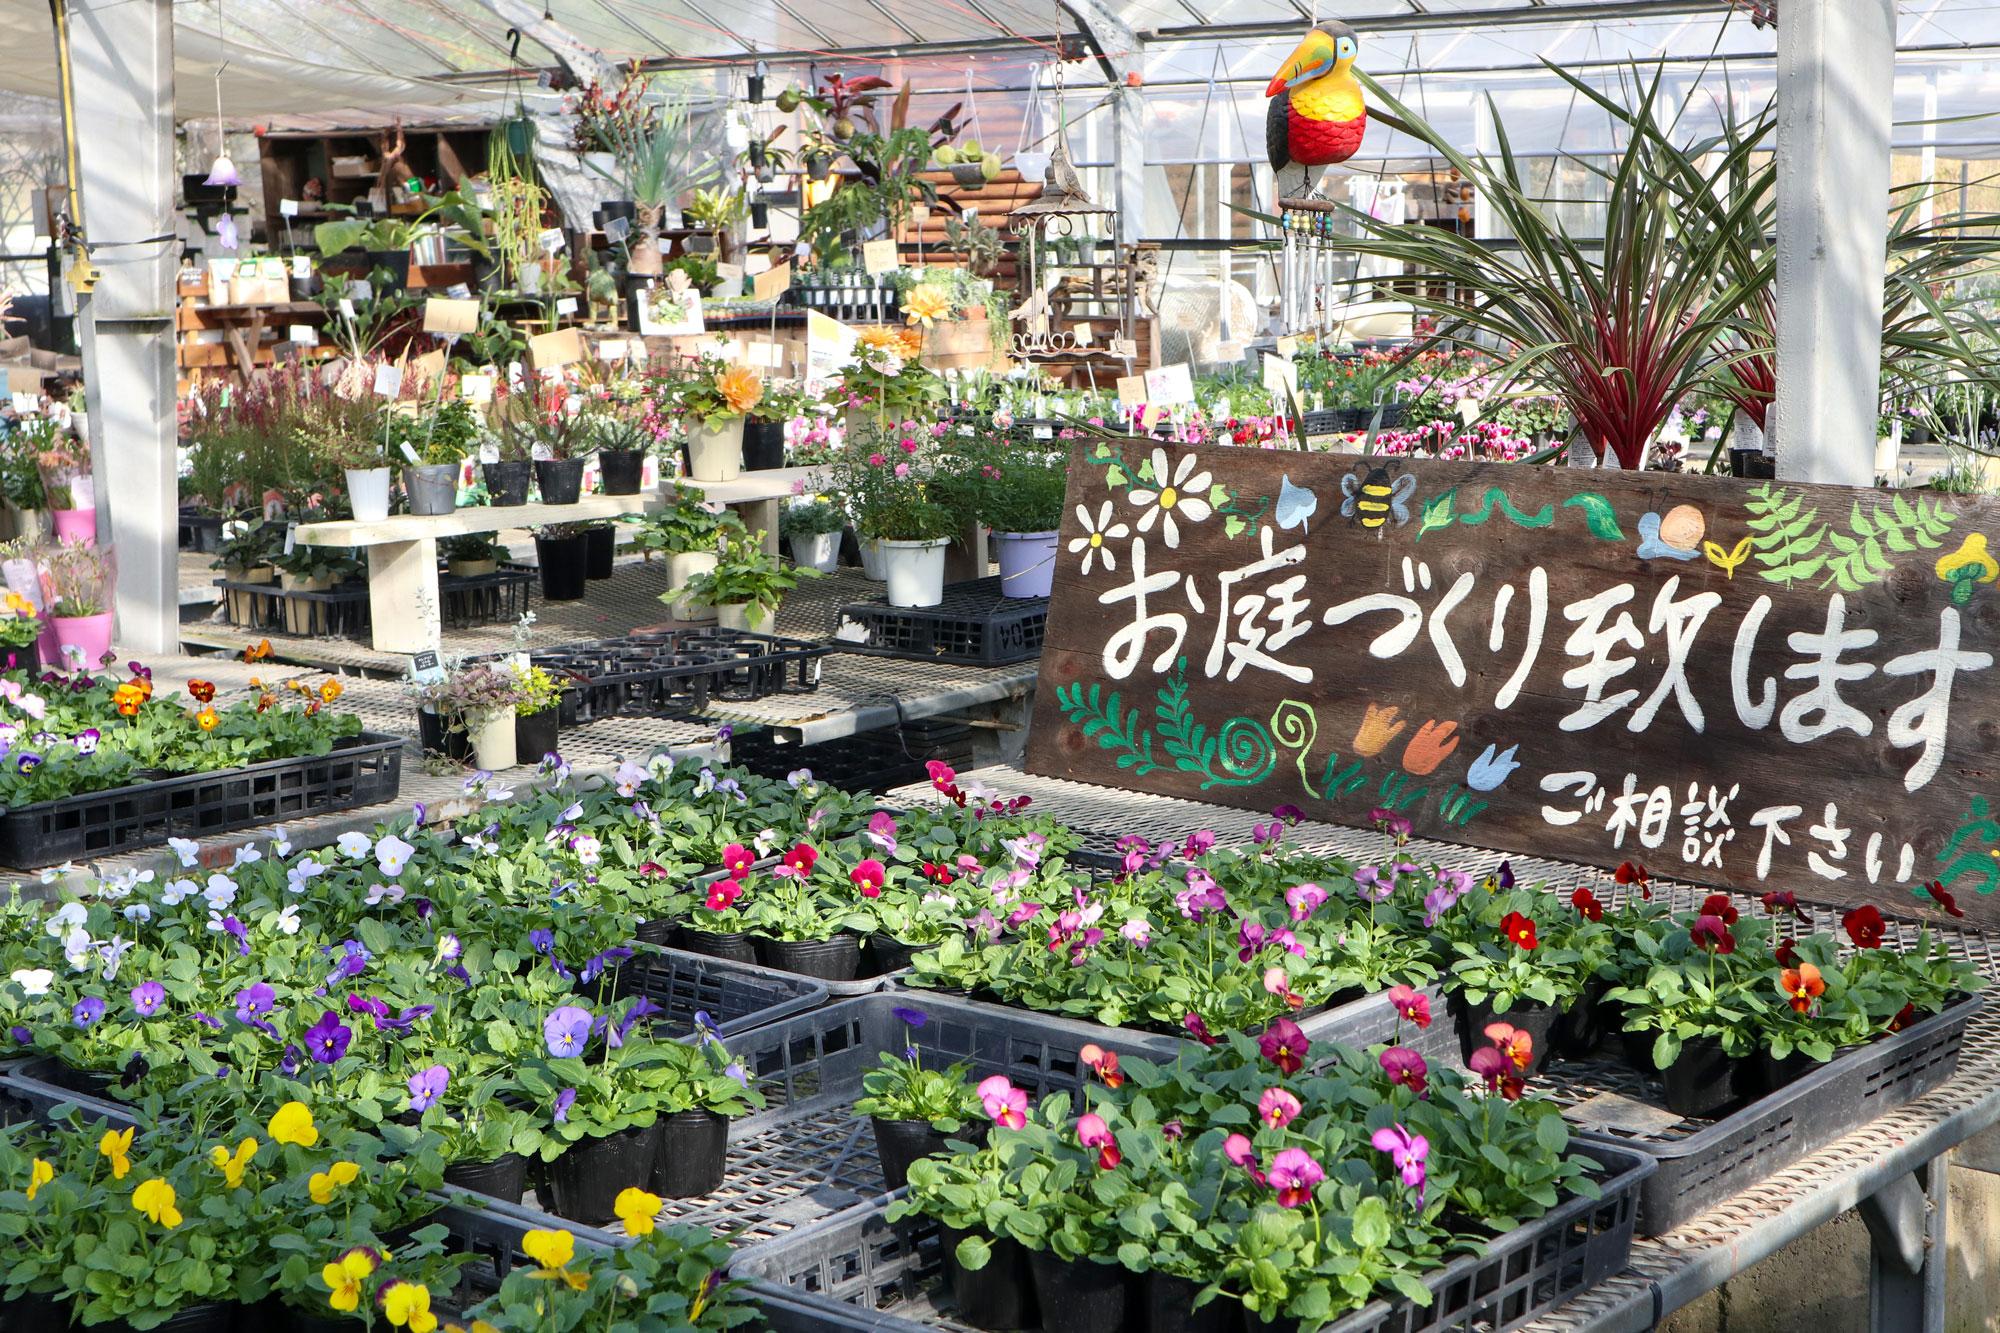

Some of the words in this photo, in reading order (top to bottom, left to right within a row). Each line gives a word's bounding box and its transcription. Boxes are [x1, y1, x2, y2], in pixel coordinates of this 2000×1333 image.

[1098, 525, 1993, 792] お庭づくり致します
[1540, 771, 1914, 884] ご相談下さい
